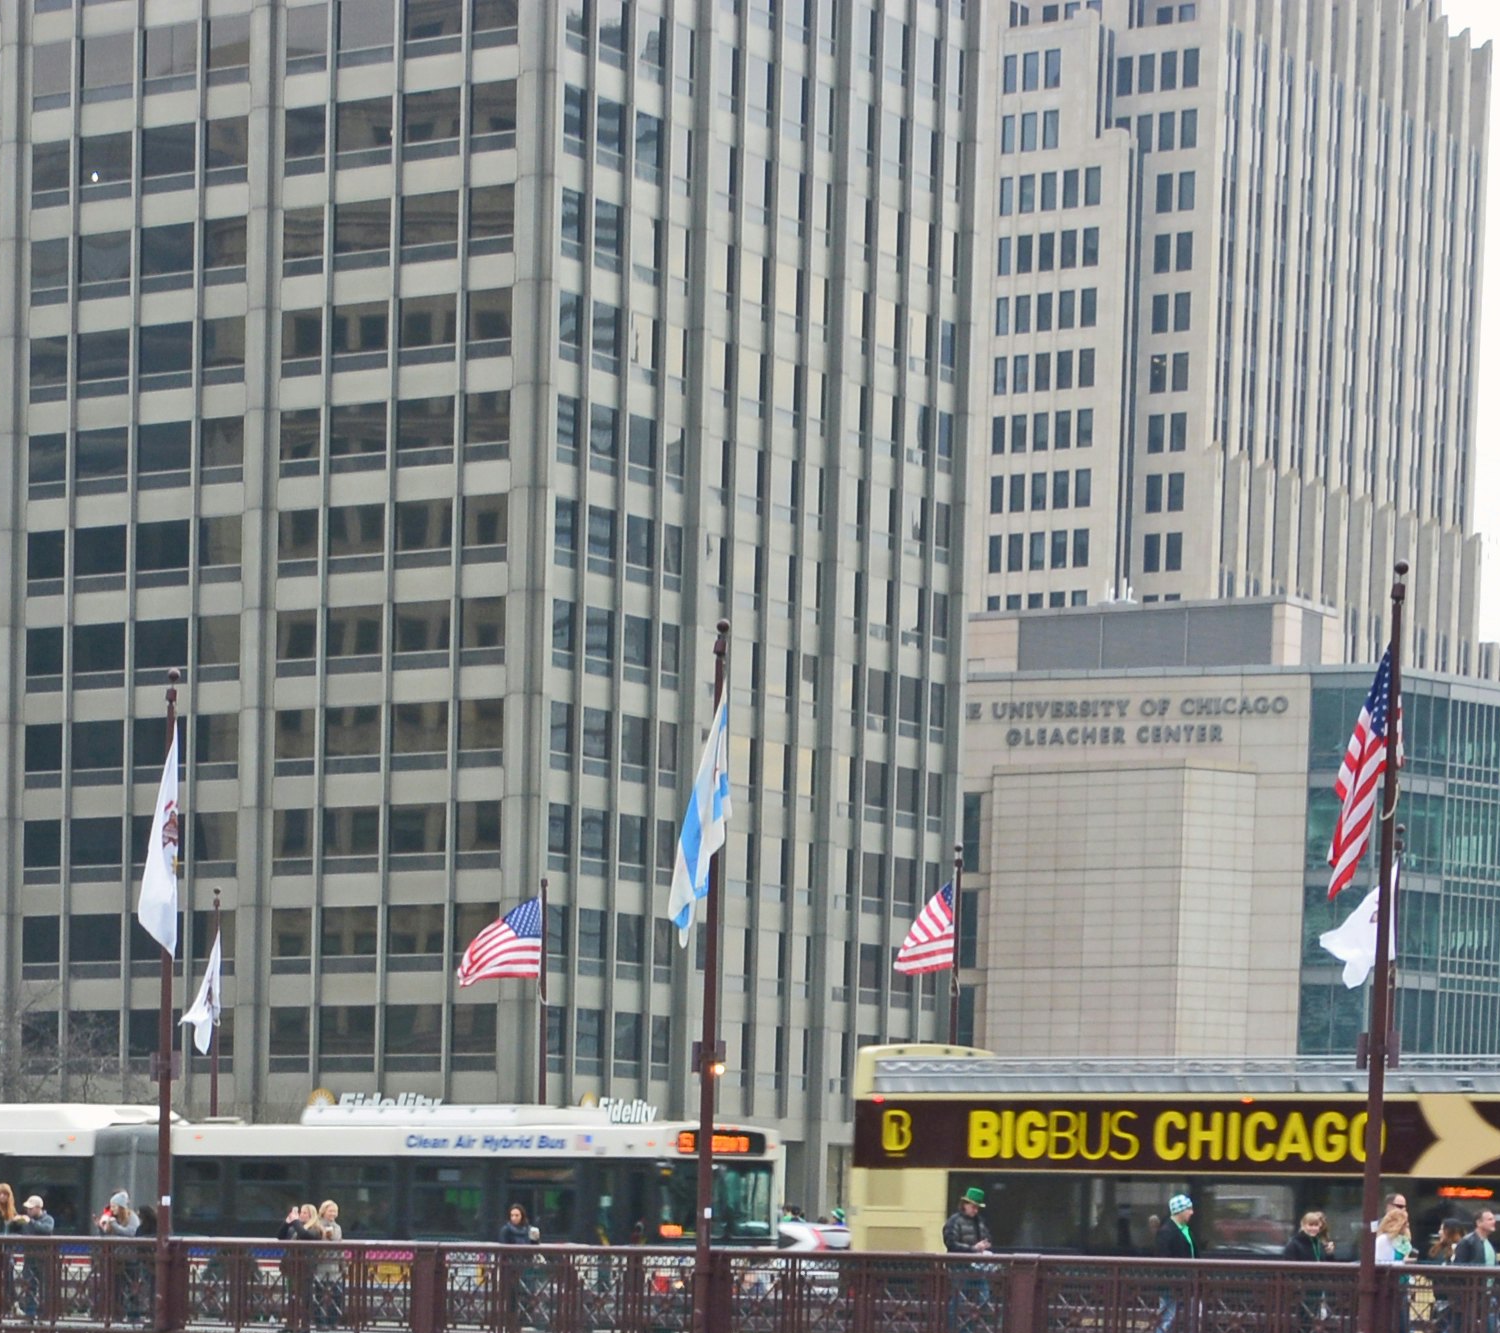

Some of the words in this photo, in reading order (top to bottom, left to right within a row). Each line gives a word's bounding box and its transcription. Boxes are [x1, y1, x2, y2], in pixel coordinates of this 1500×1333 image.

[991, 698, 1131, 720] UNIVERSITY
[1139, 698, 1170, 717] OF
[1180, 695, 1289, 716] CHICAGO
[1005, 725, 1126, 747] GLEACHER
[1135, 723, 1224, 745] CENTER
[598, 1096, 658, 1123] Fidelity
[405, 1133, 452, 1150] Clean
[454, 1134, 476, 1150] Air
[483, 1134, 533, 1152] Hybrid
[537, 1135, 567, 1151] Bus
[1153, 1110, 1387, 1163] CHICAGO
